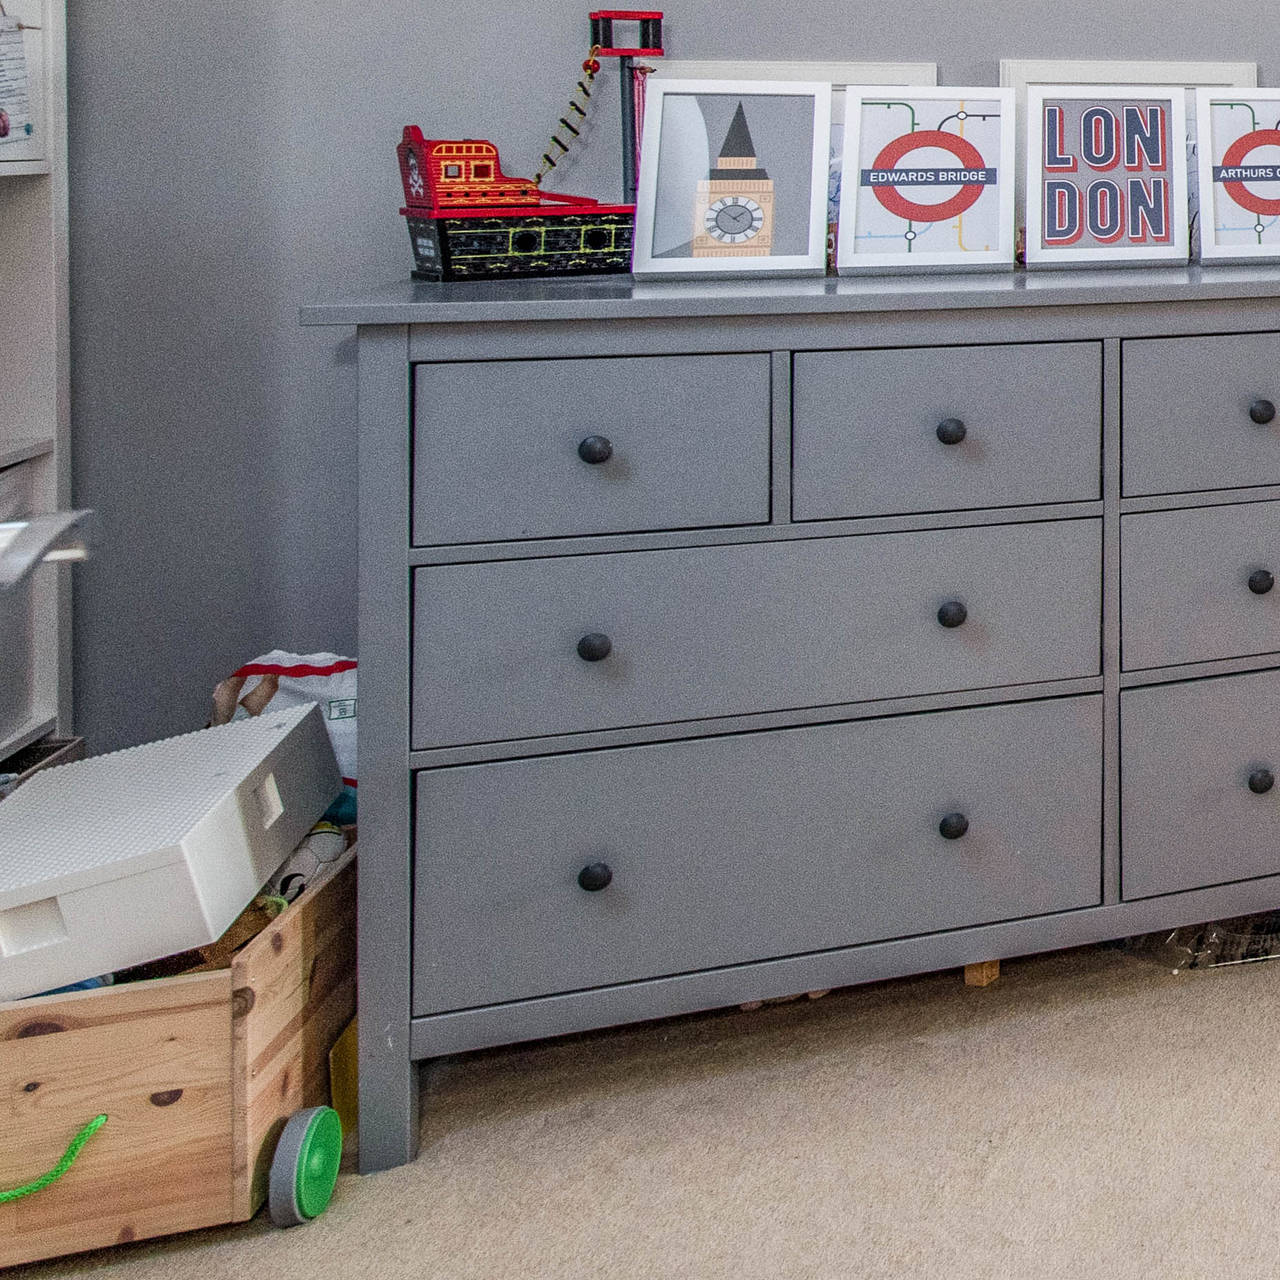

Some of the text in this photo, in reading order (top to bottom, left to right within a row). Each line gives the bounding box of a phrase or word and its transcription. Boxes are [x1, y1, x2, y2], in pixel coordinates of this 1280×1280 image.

[1044, 105, 1167, 171] LON
[870, 170, 987, 183] EDWARDS BRIDGE
[1219, 168, 1274, 179] ARTHURS
[1045, 177, 1171, 244] DON
